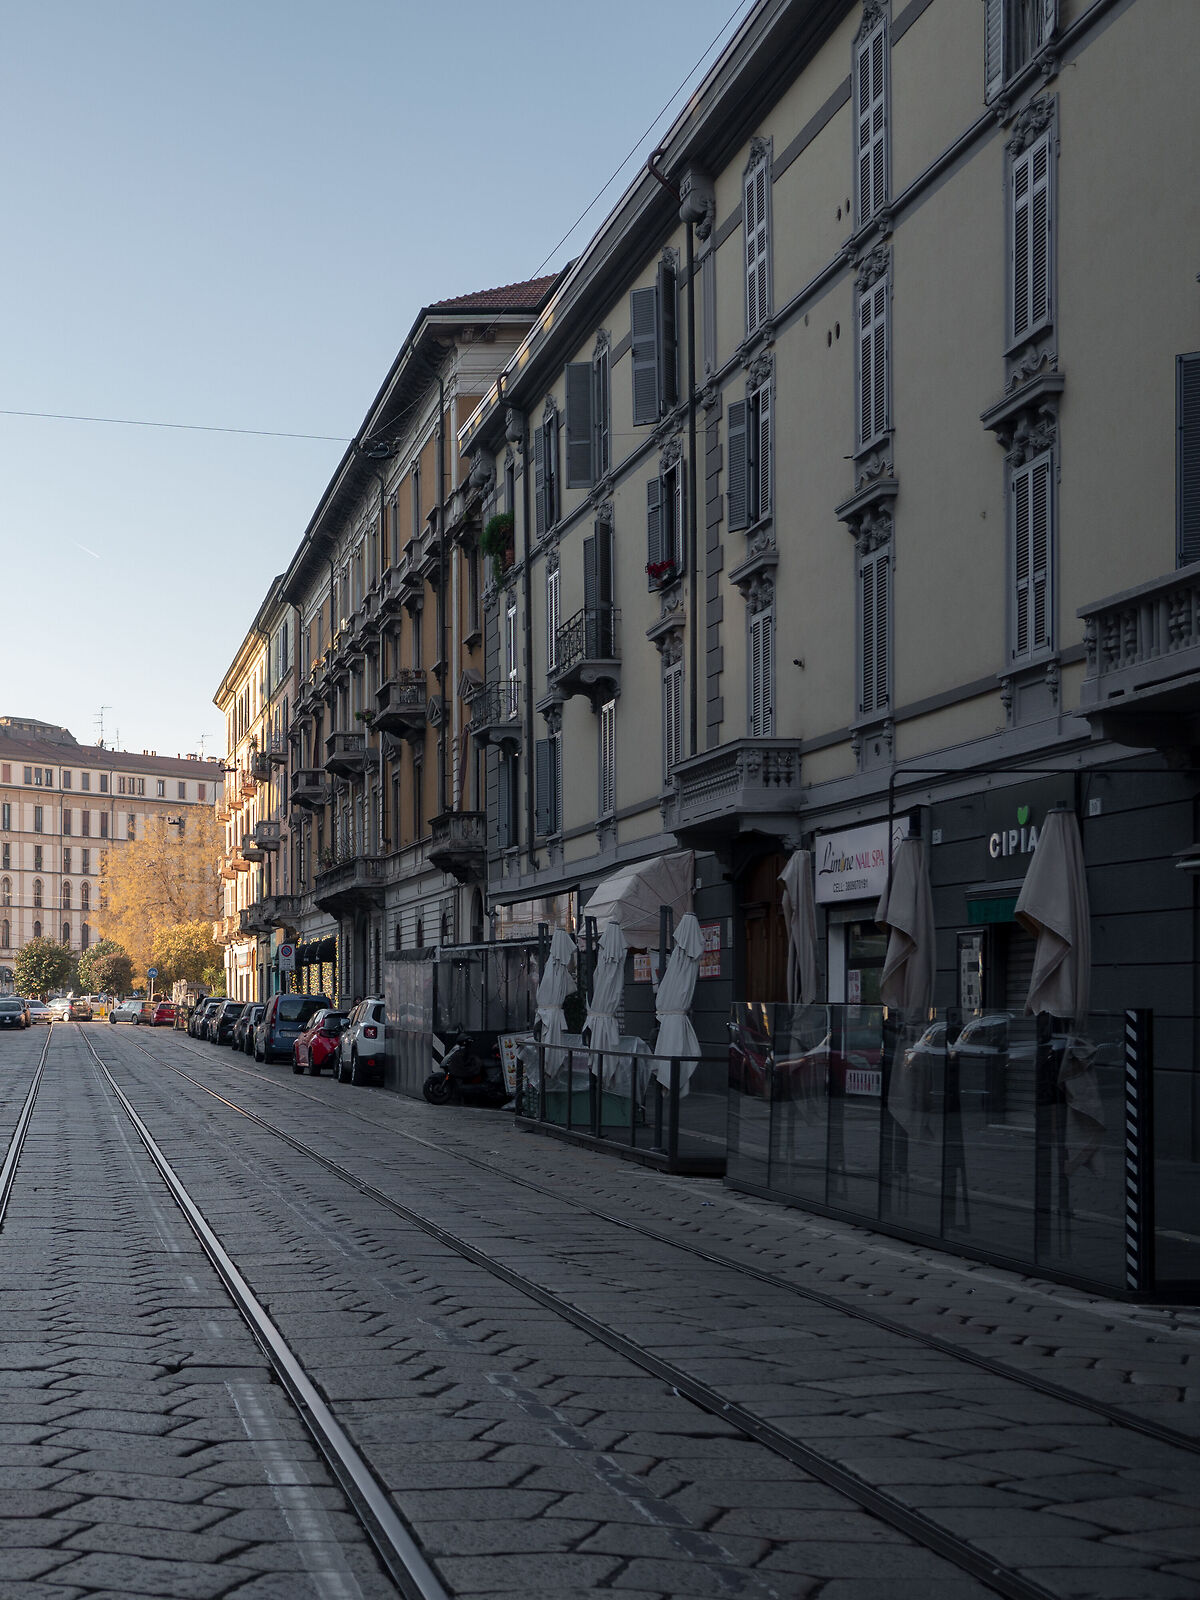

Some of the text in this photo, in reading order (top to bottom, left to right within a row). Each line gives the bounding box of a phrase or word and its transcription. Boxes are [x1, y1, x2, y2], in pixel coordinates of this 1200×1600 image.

[818, 841, 885, 875] Limone NAIL SPA
